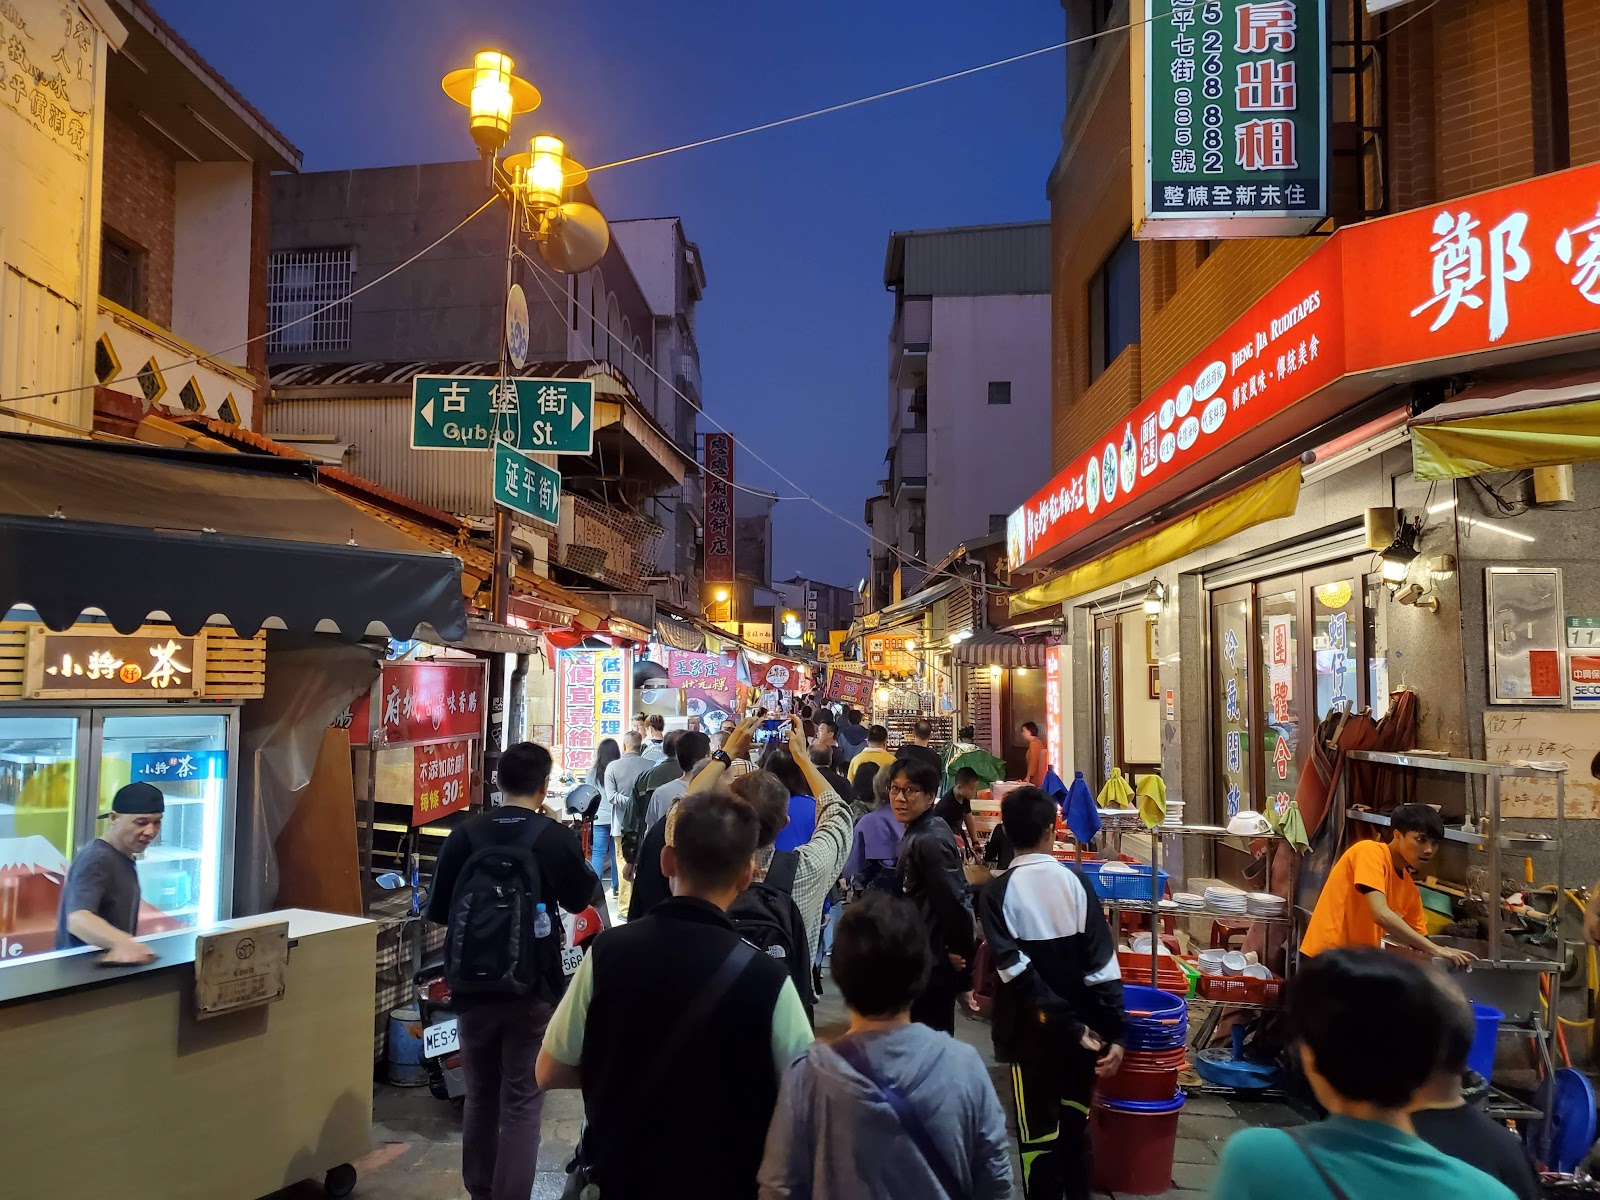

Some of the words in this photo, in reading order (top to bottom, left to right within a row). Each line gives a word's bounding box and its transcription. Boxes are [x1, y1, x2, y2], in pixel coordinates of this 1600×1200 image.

[1171, 0, 1196, 173] 平七街885號
[1234, 2, 1298, 171] 房出租
[1163, 184, 1306, 207] 整棟全新未住
[439, 382, 567, 415] 古堡街
[532, 420, 558, 445] St.
[505, 457, 551, 511] 延平街
[569, 665, 593, 769] 便宜賣給您
[601, 656, 620, 735] 低價處理
